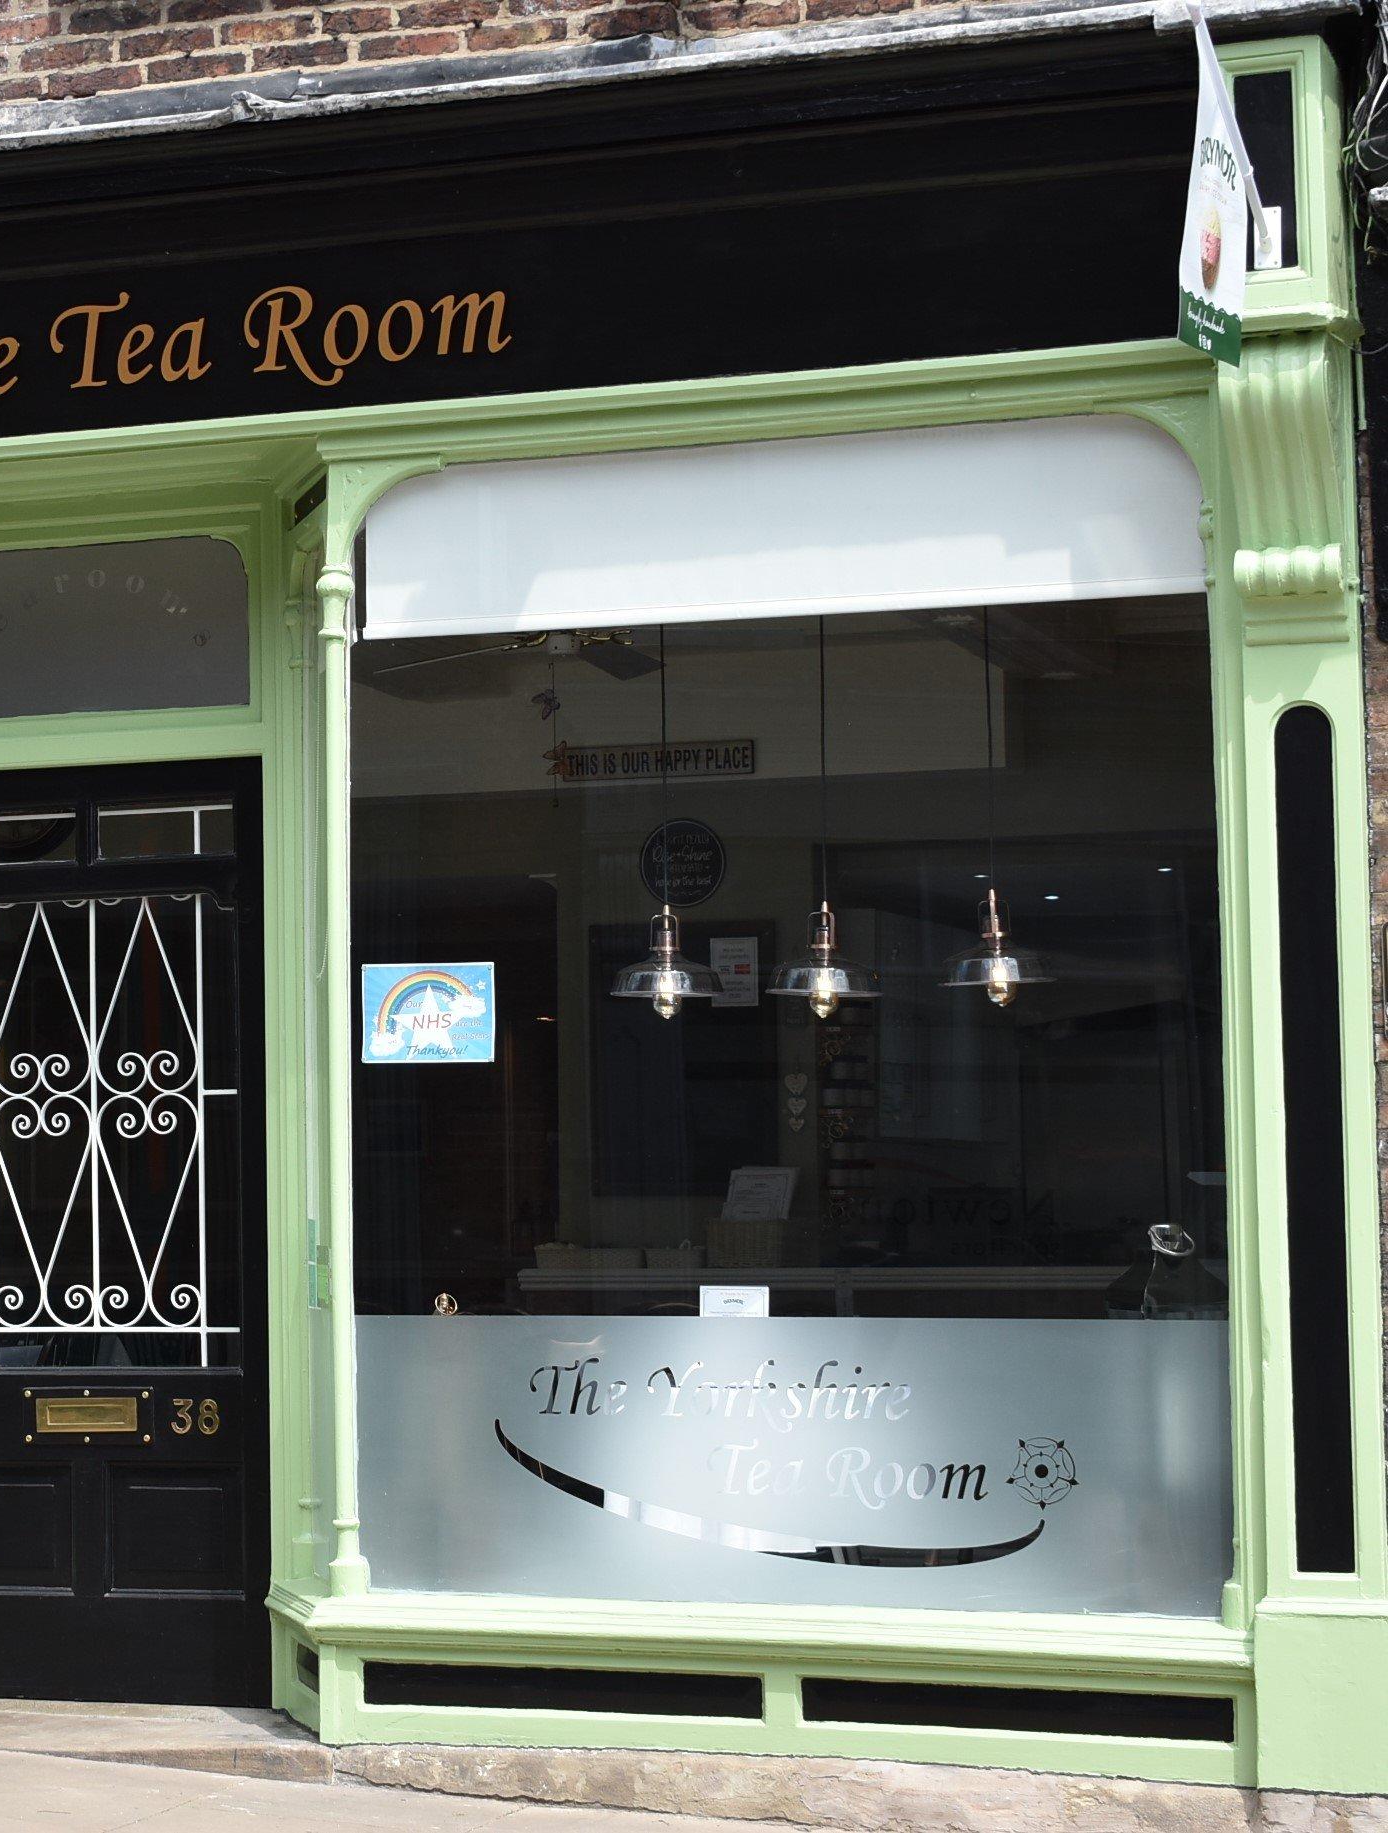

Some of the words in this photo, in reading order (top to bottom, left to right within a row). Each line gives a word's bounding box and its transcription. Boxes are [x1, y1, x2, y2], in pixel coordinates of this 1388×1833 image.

[50, 292, 211, 388] Tea
[244, 285, 511, 386] Room
[567, 752, 598, 776] THIS
[603, 752, 616, 774] IS
[621, 751, 650, 773] OUR
[655, 748, 701, 772] HAPPY
[706, 746, 750, 769] PLACE
[412, 1013, 452, 1030] NHS
[405, 1044, 468, 1058] Thankyou!
[530, 1357, 627, 1415] The
[647, 1359, 912, 1433] Yorkshire
[170, 1398, 221, 1435] 38
[707, 1438, 808, 1496] Tea
[826, 1446, 989, 1511] Room
